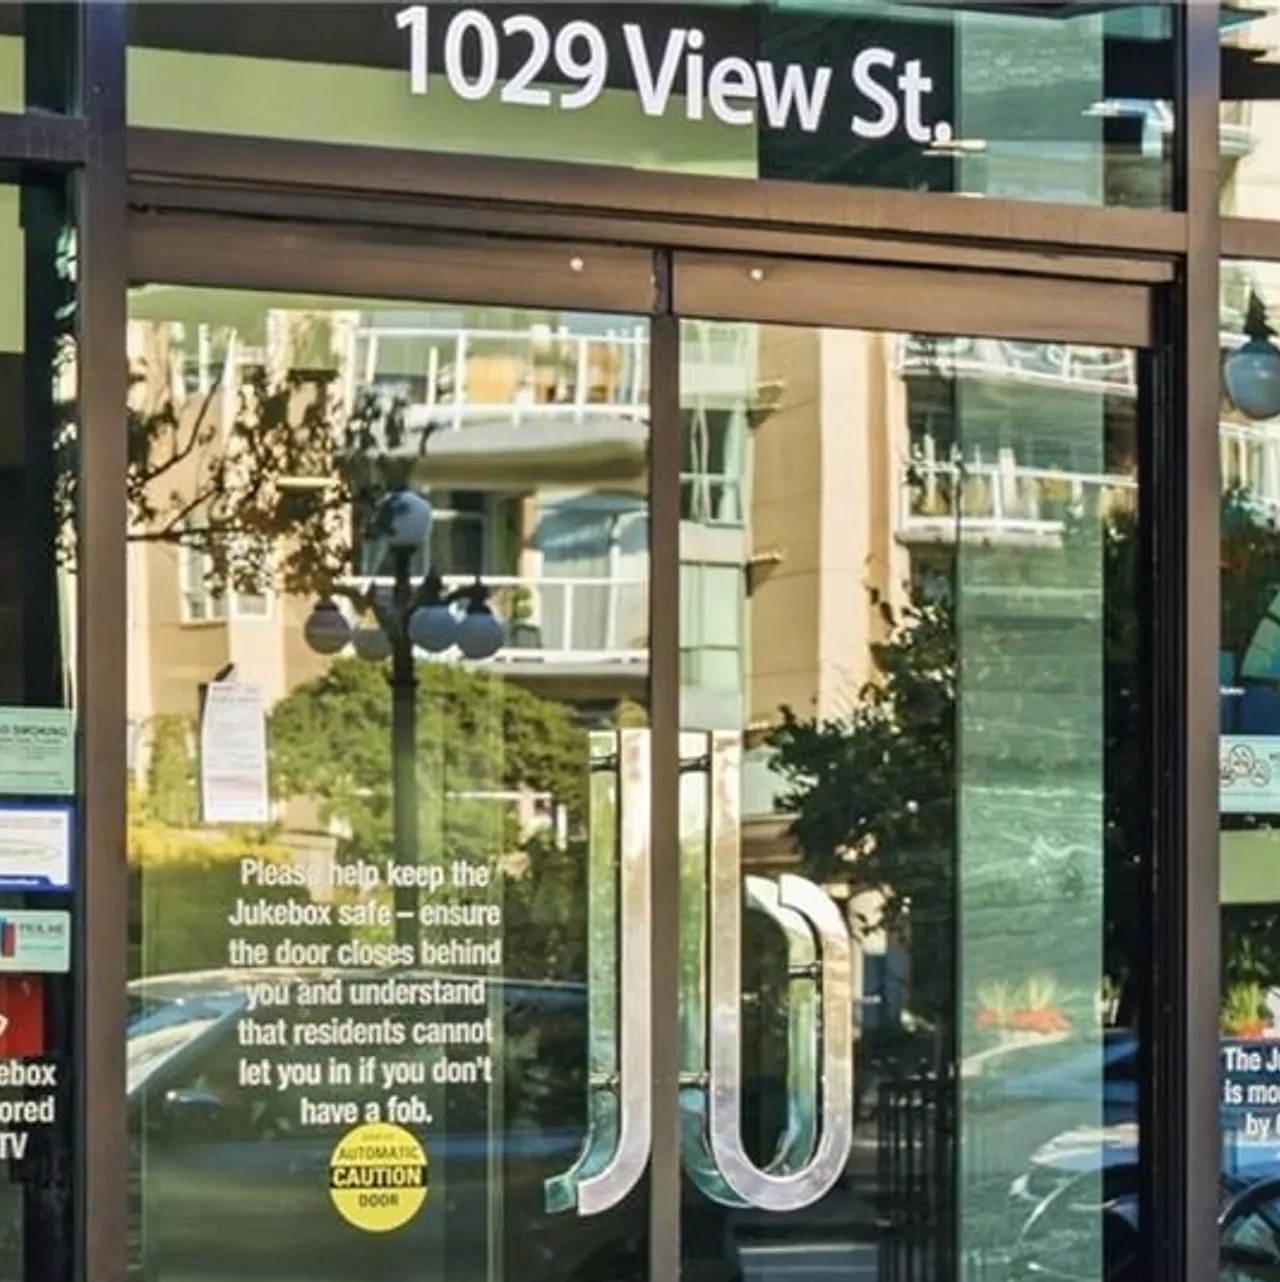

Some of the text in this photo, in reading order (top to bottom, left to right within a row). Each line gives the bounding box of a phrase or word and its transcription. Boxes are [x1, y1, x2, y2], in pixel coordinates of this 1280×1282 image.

[396, 6, 952, 143] 1029 View St.
[329, 859, 379, 890] help
[387, 859, 444, 891] keep
[452, 860, 490, 885] the
[228, 899, 332, 926] Jukebox
[337, 899, 392, 926] safe
[421, 904, 501, 926] ensure
[228, 939, 502, 967] the door closes behind
[244, 979, 486, 1010] you and understand
[237, 1019, 494, 1046] that residents cannot
[1222, 1046, 1262, 1072] The
[238, 1057, 493, 1091] let you in if you don't
[1224, 1079, 1243, 1104] is
[300, 1097, 433, 1125] have a fob.
[1245, 1112, 1270, 1139] by
[339, 1146, 420, 1161] AUTOMATIC
[332, 1168, 422, 1187] CAUTION
[359, 1193, 399, 1208] DOOR
